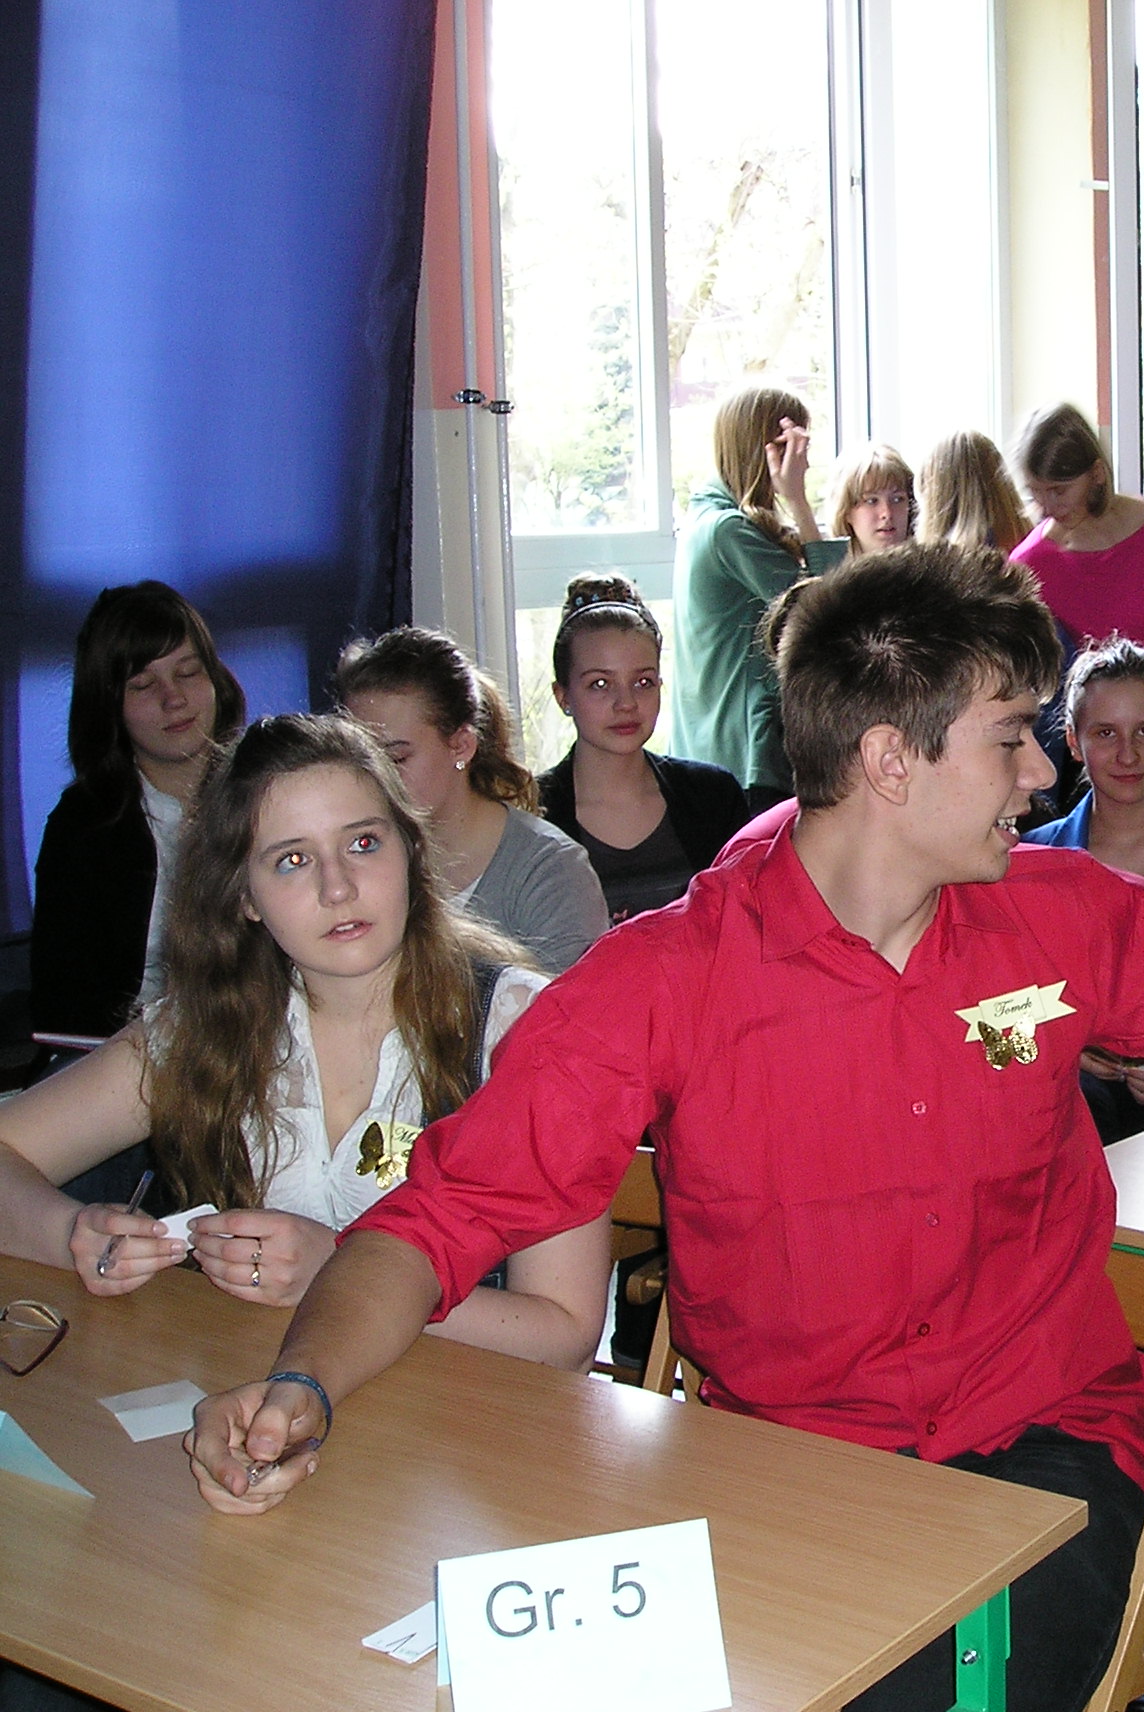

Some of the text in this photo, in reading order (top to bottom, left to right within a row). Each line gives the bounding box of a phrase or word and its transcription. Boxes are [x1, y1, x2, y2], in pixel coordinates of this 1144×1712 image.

[993, 997, 1033, 1018] Tomek
[486, 1561, 647, 1638] Gr. 5
